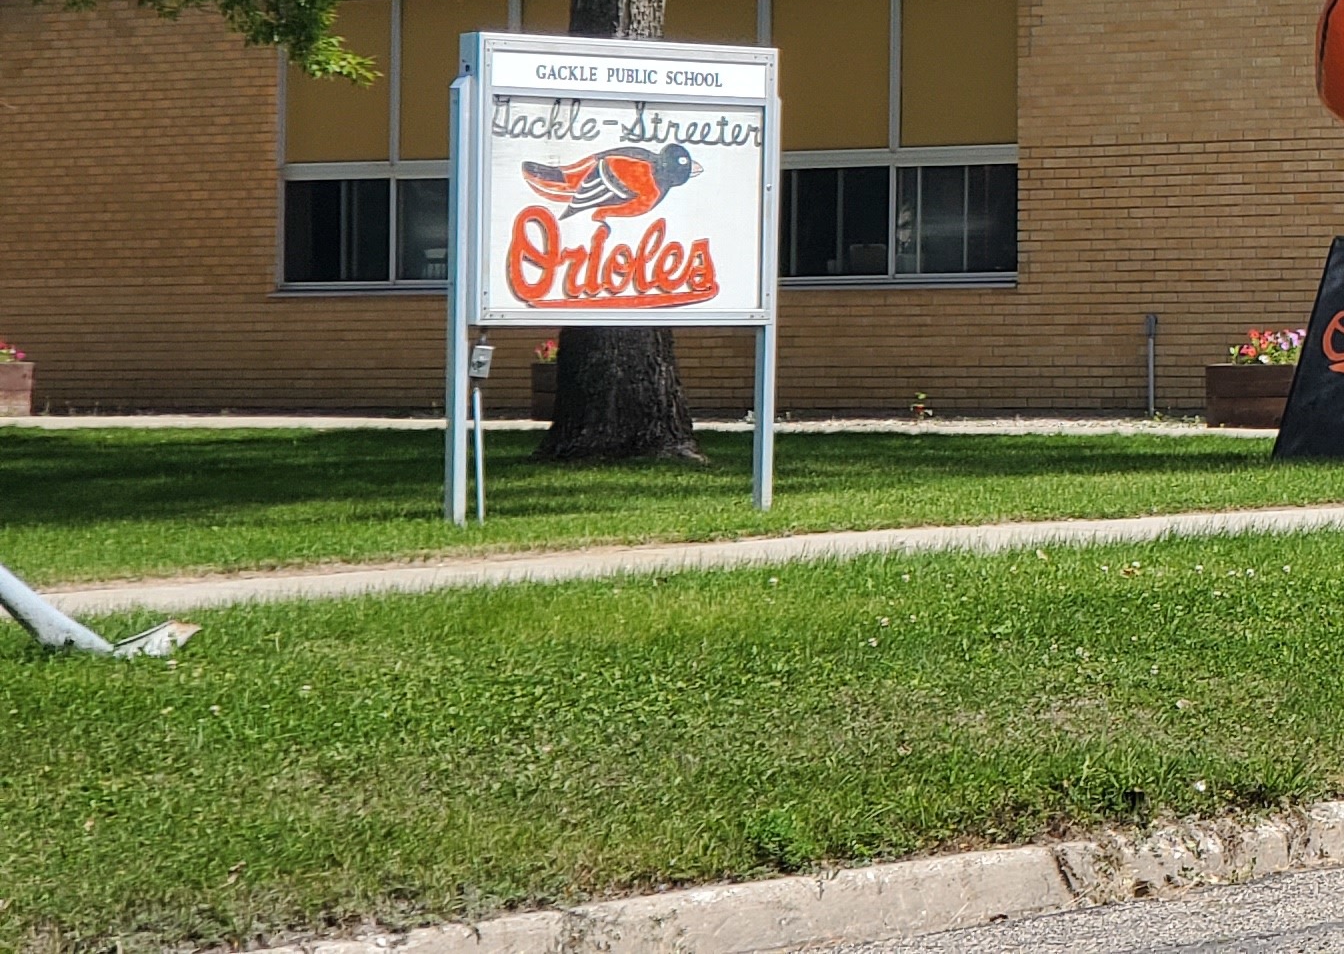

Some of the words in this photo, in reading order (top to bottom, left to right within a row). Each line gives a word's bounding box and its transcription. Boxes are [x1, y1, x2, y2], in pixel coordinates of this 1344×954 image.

[535, 64, 598, 82] GACKLE
[606, 67, 658, 85] PUBLIC
[665, 70, 723, 88] SCHOOL
[491, 95, 763, 147] Gackle-Streeter
[506, 205, 720, 304] Orioles
